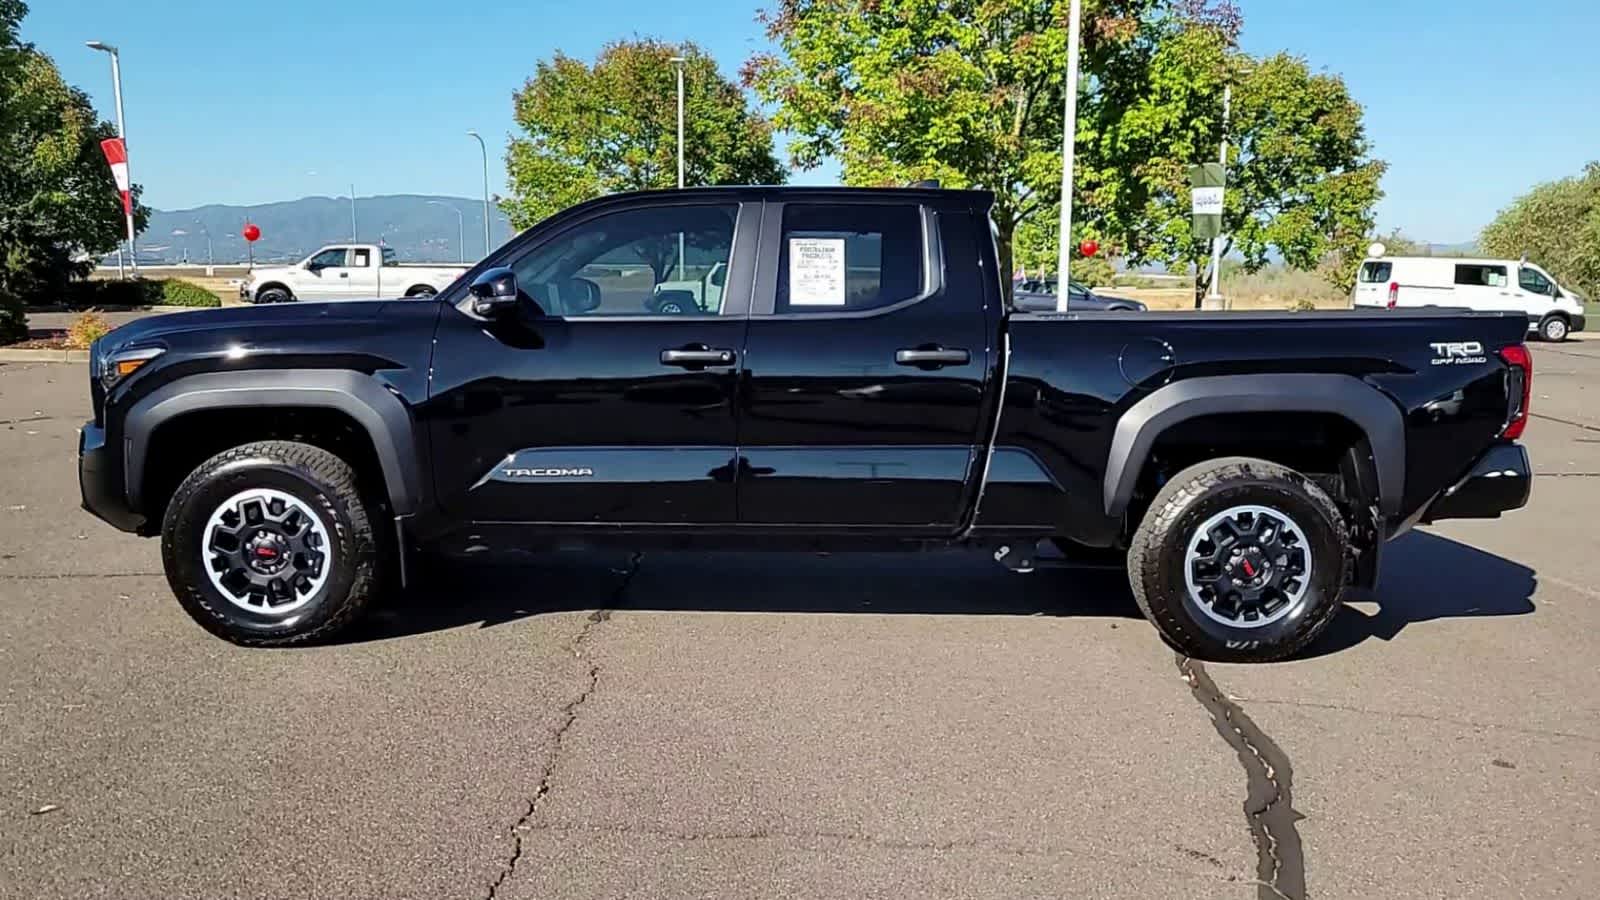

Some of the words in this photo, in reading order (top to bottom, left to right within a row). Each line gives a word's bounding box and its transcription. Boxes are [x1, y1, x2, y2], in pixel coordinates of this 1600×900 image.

[1429, 341, 1484, 357] TRD
[1431, 357, 1454, 365] OFF
[502, 468, 593, 476] TACOMA
